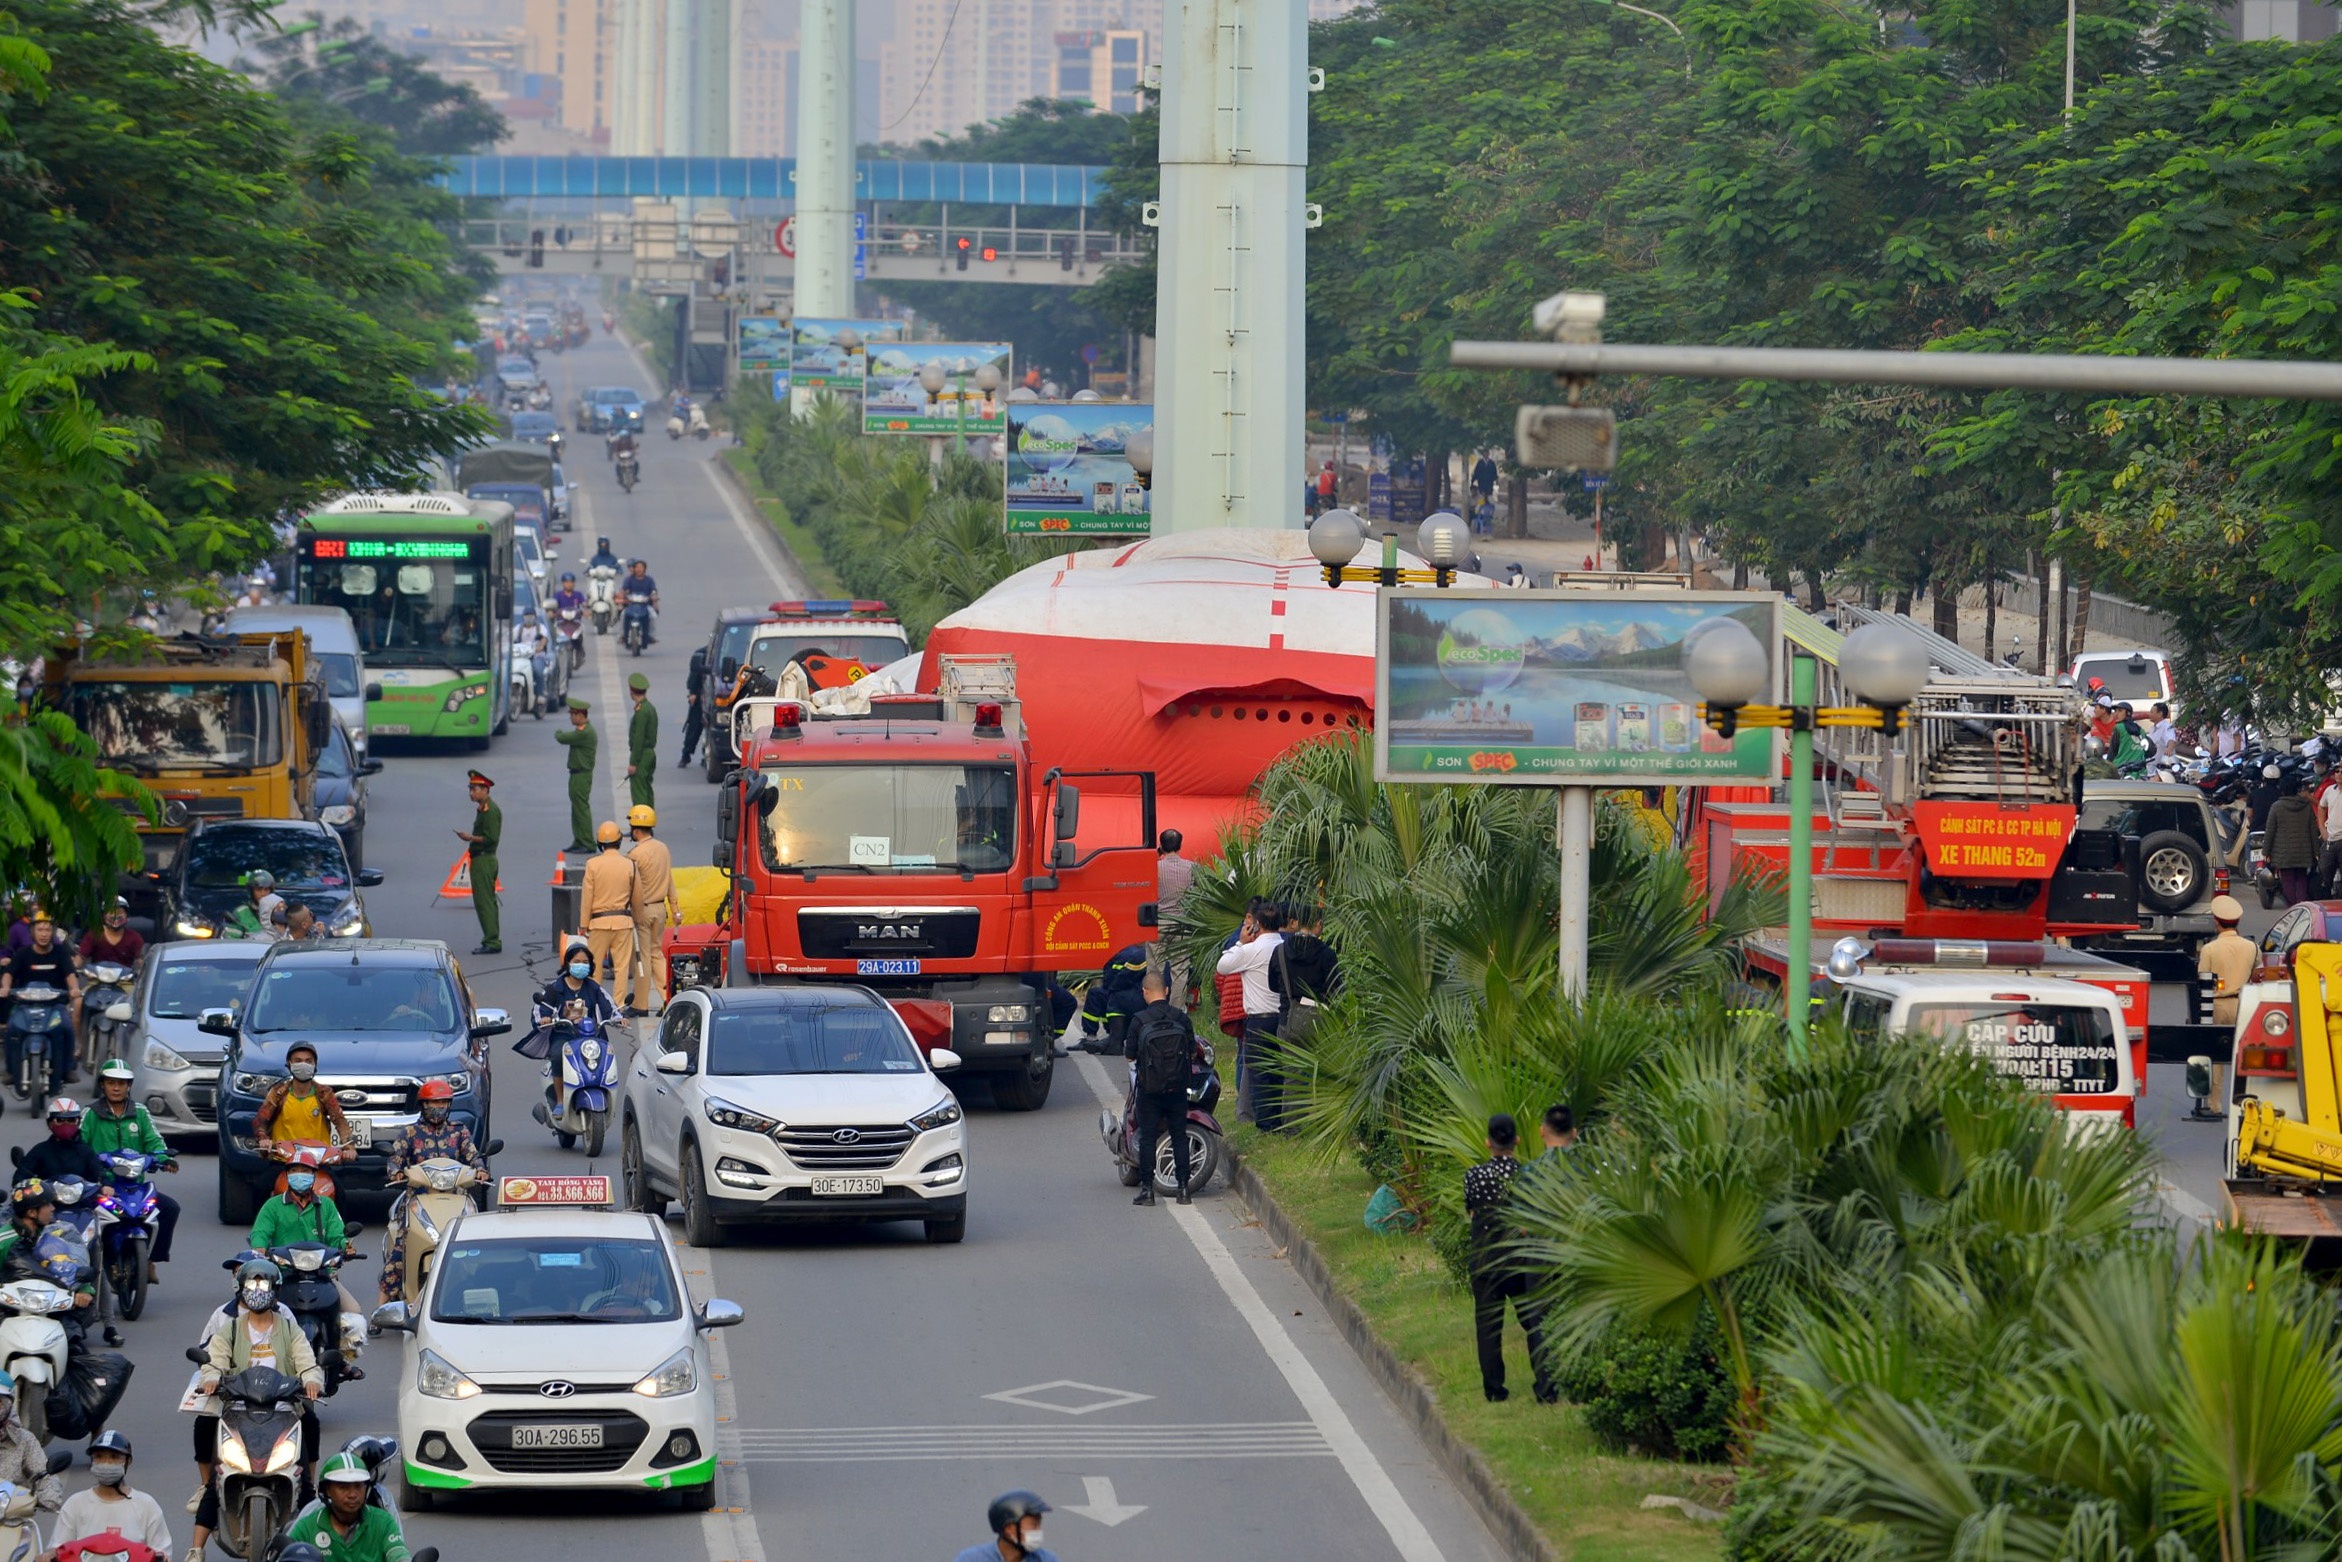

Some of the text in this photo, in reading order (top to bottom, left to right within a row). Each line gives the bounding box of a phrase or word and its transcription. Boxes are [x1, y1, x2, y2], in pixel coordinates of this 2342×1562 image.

[1028, 439, 1077, 452] ecoSpec
[1019, 520, 1036, 528] SƠN
[1043, 518, 1068, 531] SPEC
[1080, 521, 1108, 529] CHUNG
[1110, 521, 1125, 529] TAY
[1126, 519, 1135, 529] VÌ
[1451, 644, 1523, 665] ecoSpec
[1437, 756, 1462, 767] SƠN
[1474, 751, 1512, 771] SPEC
[1532, 758, 1574, 768] CHUNG
[1579, 758, 1600, 768] TAY
[1602, 757, 1616, 768] VÌ
[1619, 756, 1645, 769] MỘT
[1649, 756, 1673, 769] THẾ
[1675, 757, 1701, 769] GIỚI
[1704, 759, 1738, 769] XANH
[780, 778, 804, 791] TX
[1939, 813, 2062, 840] CẢNH SÁT PC & CC TP HÀ NỘI
[854, 843, 885, 856] CN2
[1939, 845, 2047, 867] XE THANG 52m
[1044, 920, 1057, 941] CÔNG
[1053, 910, 1064, 922] AN
[1062, 902, 1081, 915] QUẬN
[1081, 903, 1102, 921] THANH
[858, 925, 920, 939] MAN
[788, 965, 828, 973] rosenbauer
[859, 960, 919, 974] 29A-023.11
[1966, 1016, 2056, 1044] CẤP CỨU
[1994, 1042, 2039, 1059] NGƯỜI
[2073, 1078, 2106, 1093] TTYT
[583, 1178, 604, 1186] VÀNG
[814, 1178, 881, 1193] 30E-173.50
[515, 1428, 600, 1446] 30A-296.55
